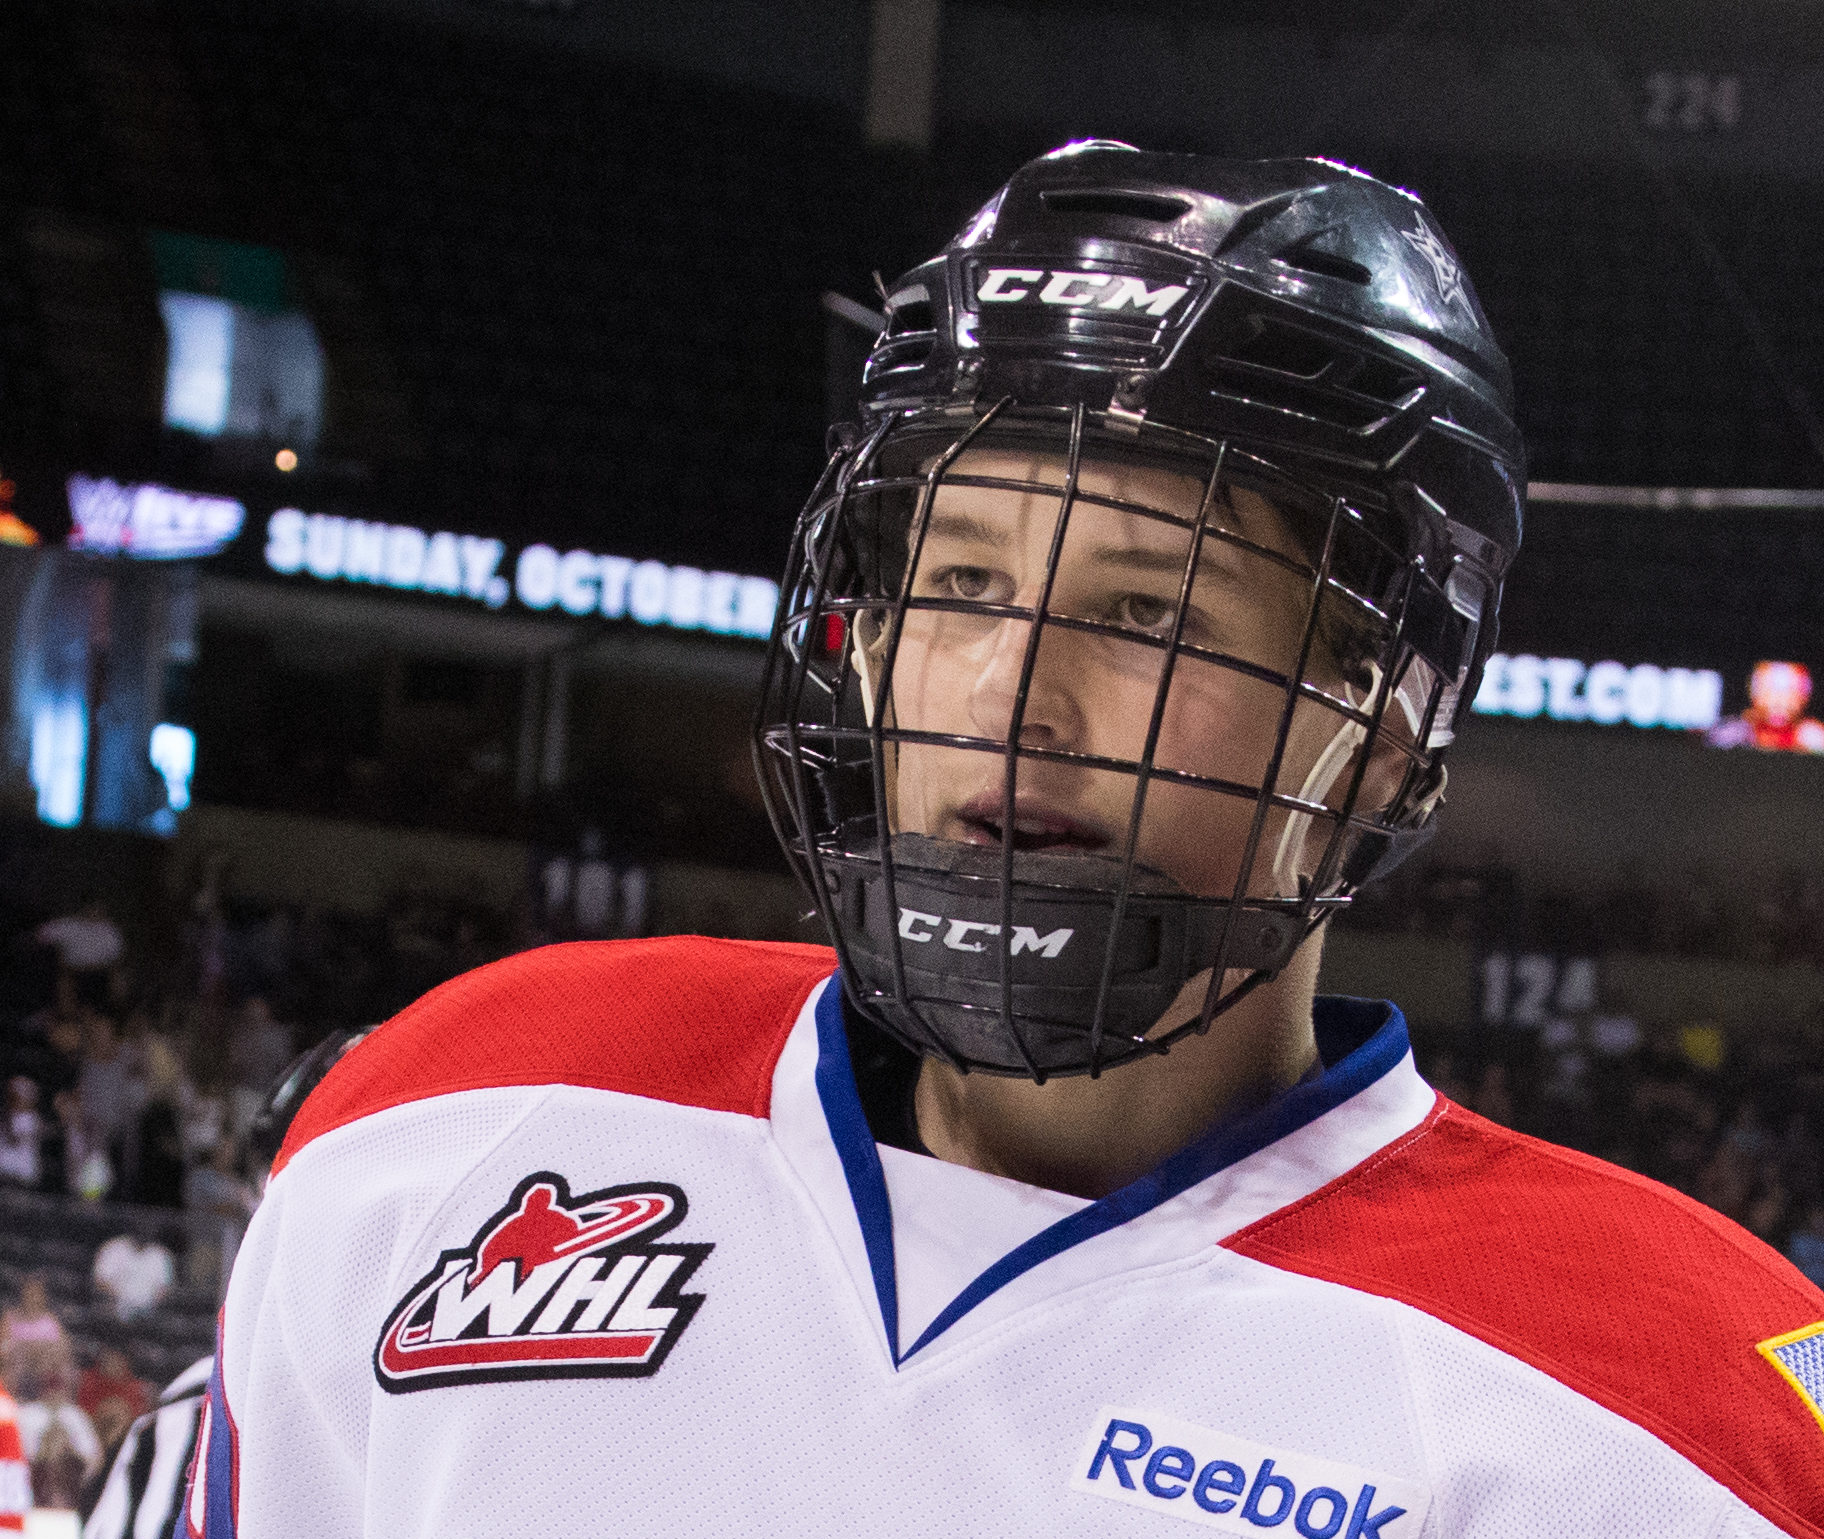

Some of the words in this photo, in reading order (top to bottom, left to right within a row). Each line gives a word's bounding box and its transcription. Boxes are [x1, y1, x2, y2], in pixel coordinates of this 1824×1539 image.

[976, 267, 1190, 317] CCM
[264, 508, 510, 610] SUNDAY,
[516, 543, 781, 641] OCTOBER
[896, 907, 1076, 958] CCM
[1482, 952, 1597, 1025] 124
[427, 1255, 686, 1345] WHL
